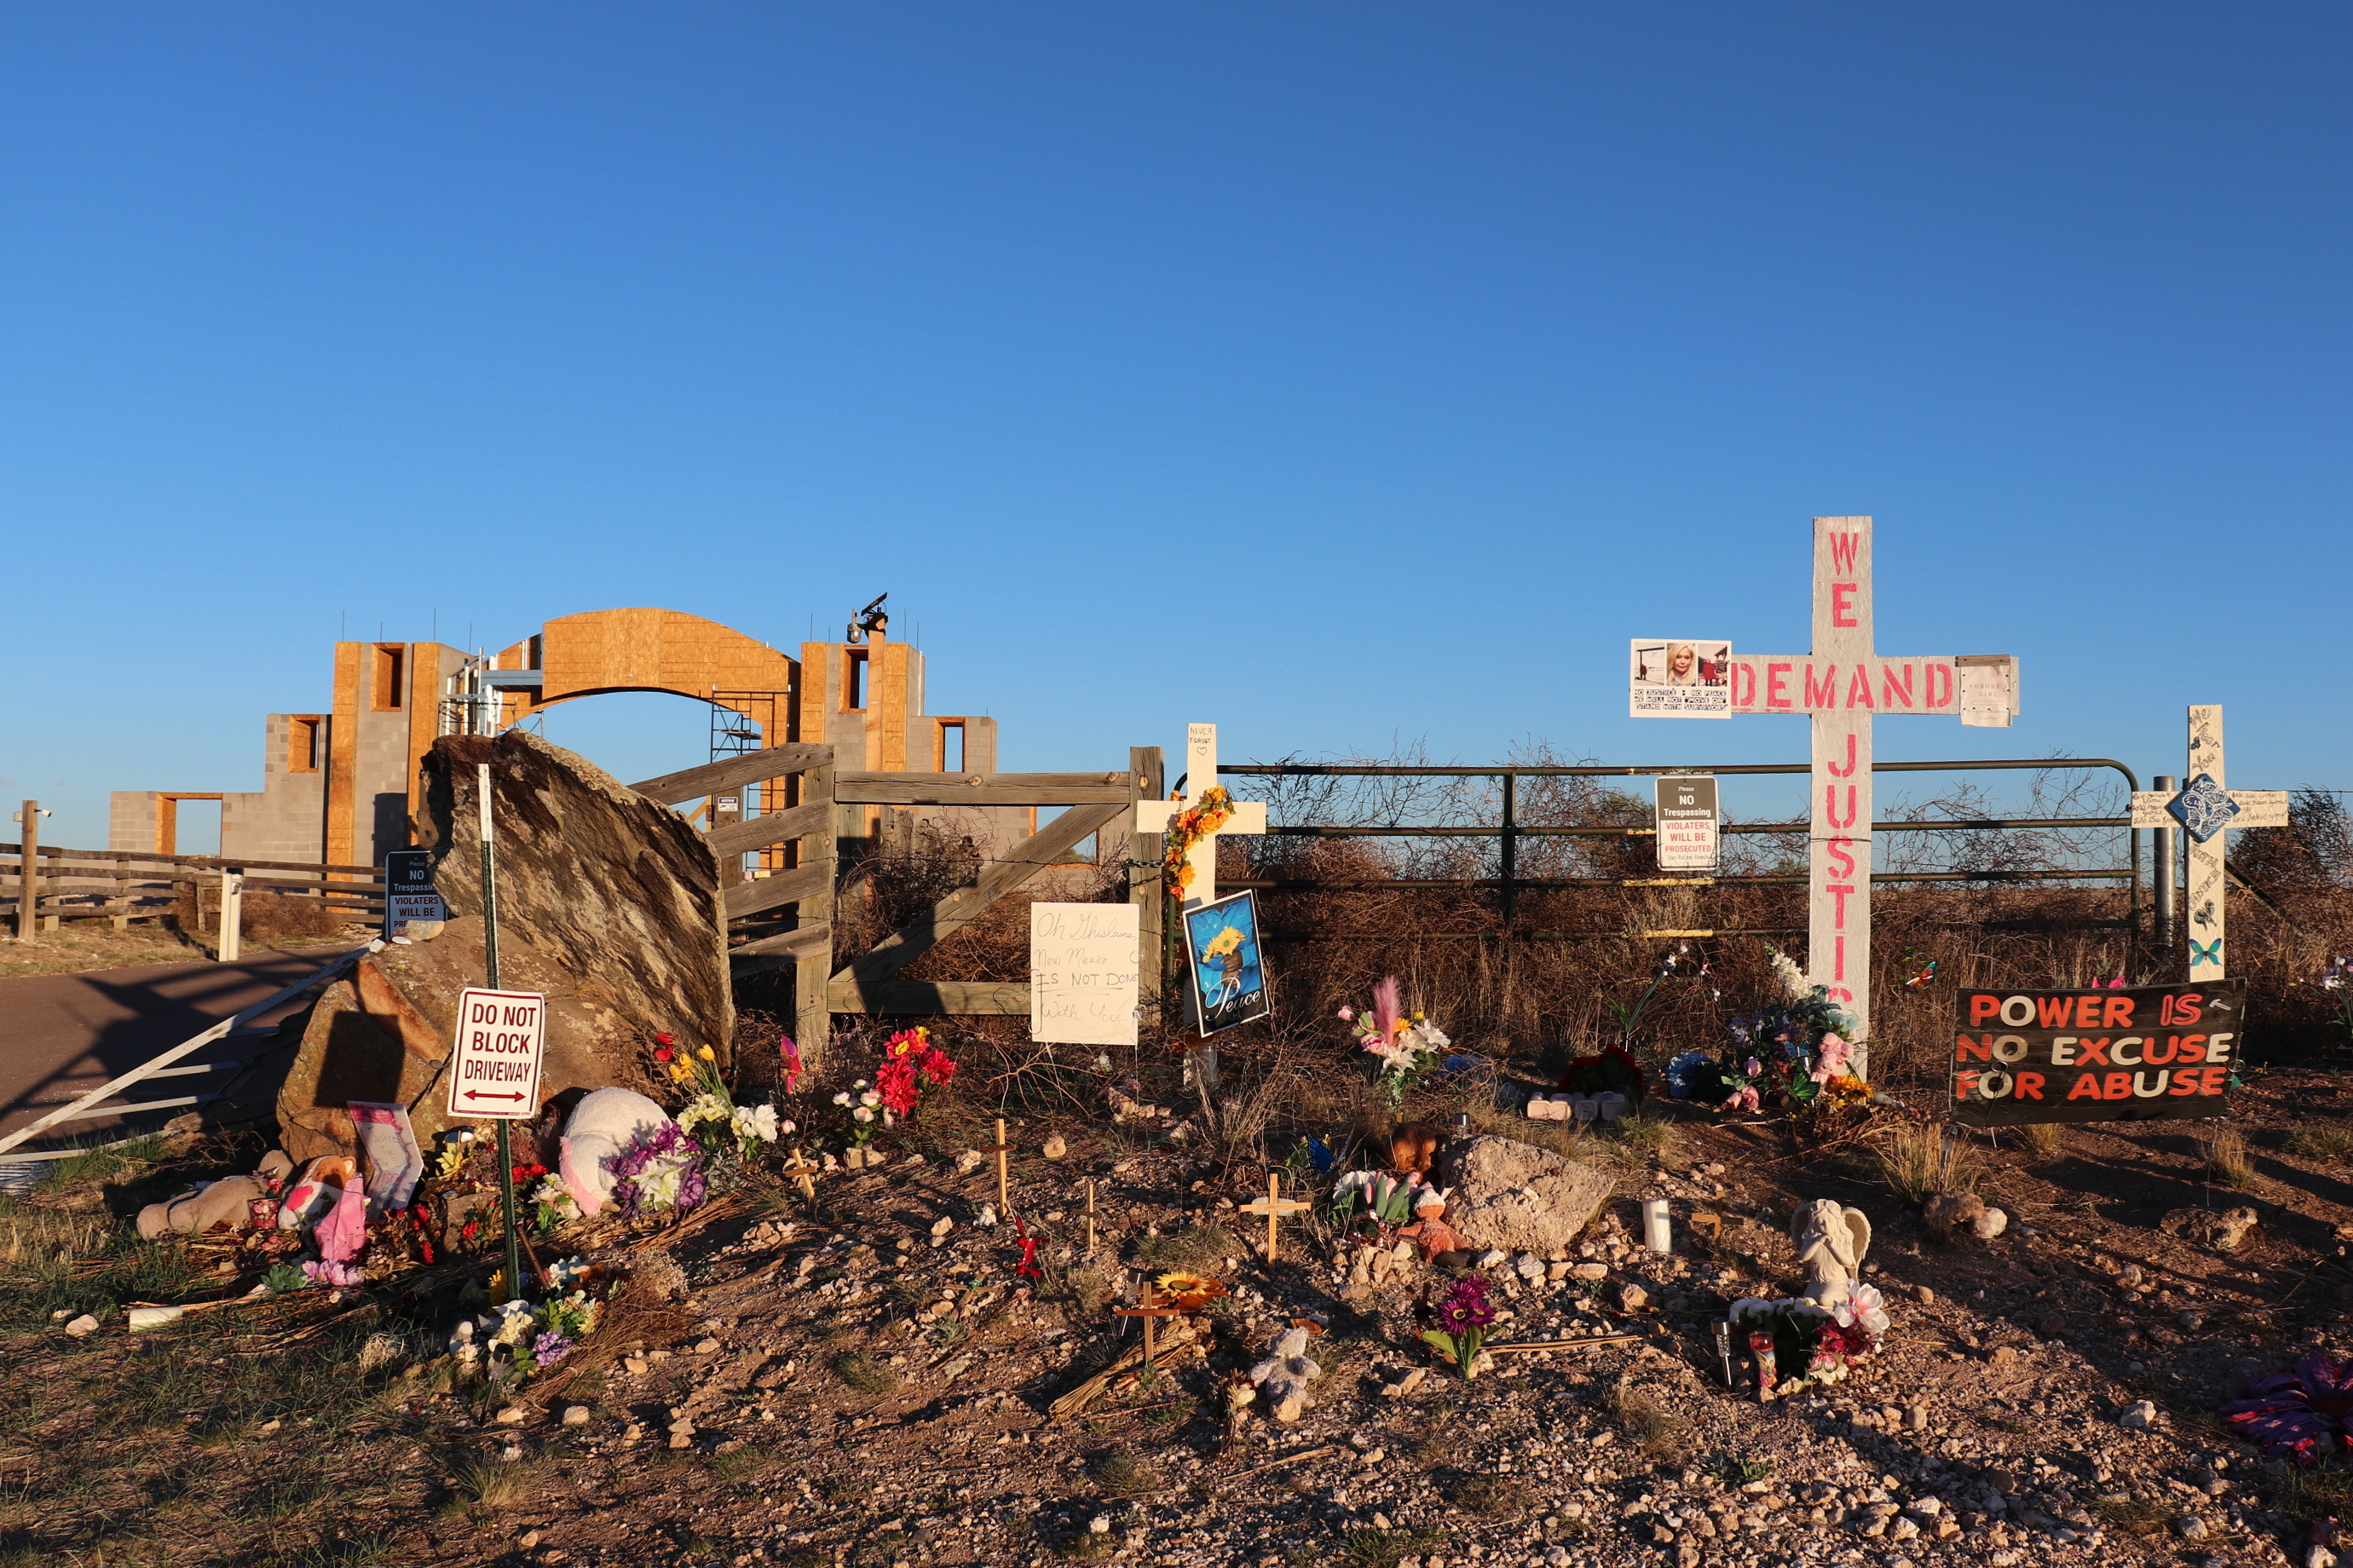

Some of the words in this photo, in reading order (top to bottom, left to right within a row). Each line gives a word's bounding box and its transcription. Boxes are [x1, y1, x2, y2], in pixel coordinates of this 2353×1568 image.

[1830, 532, 1859, 627] WE
[1731, 662, 1952, 708] DEMAND
[1190, 727, 1213, 735] NEVER
[1679, 795, 1694, 805] NO
[1664, 808, 1711, 818] Trespassing
[1665, 821, 1710, 830] VIOLATERS
[1670, 833, 1692, 842] WILL
[1694, 833, 1706, 842] BE
[1665, 845, 1711, 853] PROSECUTED
[409, 870, 424, 880] NO
[1825, 734, 1857, 1004] JUSTI
[395, 896, 439, 905] VIOLATERS
[399, 908, 421, 917] WILL
[424, 908, 435, 917] BE
[1036, 912, 1065, 940] Oh
[1034, 948, 1061, 966] New
[1066, 948, 1108, 967] Mexico
[1071, 972, 1100, 987] NOT
[1106, 972, 1139, 986] DONE
[1204, 975, 1261, 1022] Peace
[471, 1003, 498, 1024] DO
[503, 1006, 537, 1028] NOT
[1041, 1000, 1082, 1021] With
[1969, 994, 2135, 1029] POWER
[2160, 994, 2203, 1027] IS
[472, 1030, 532, 1054] BLOCK
[1956, 1034, 2028, 1063] NO
[2050, 1032, 2235, 1066] EXCUSE
[464, 1059, 532, 1082] DRIVEWAY
[1956, 1070, 2045, 1101] FOR
[2067, 1067, 2228, 1101] ABUSE
